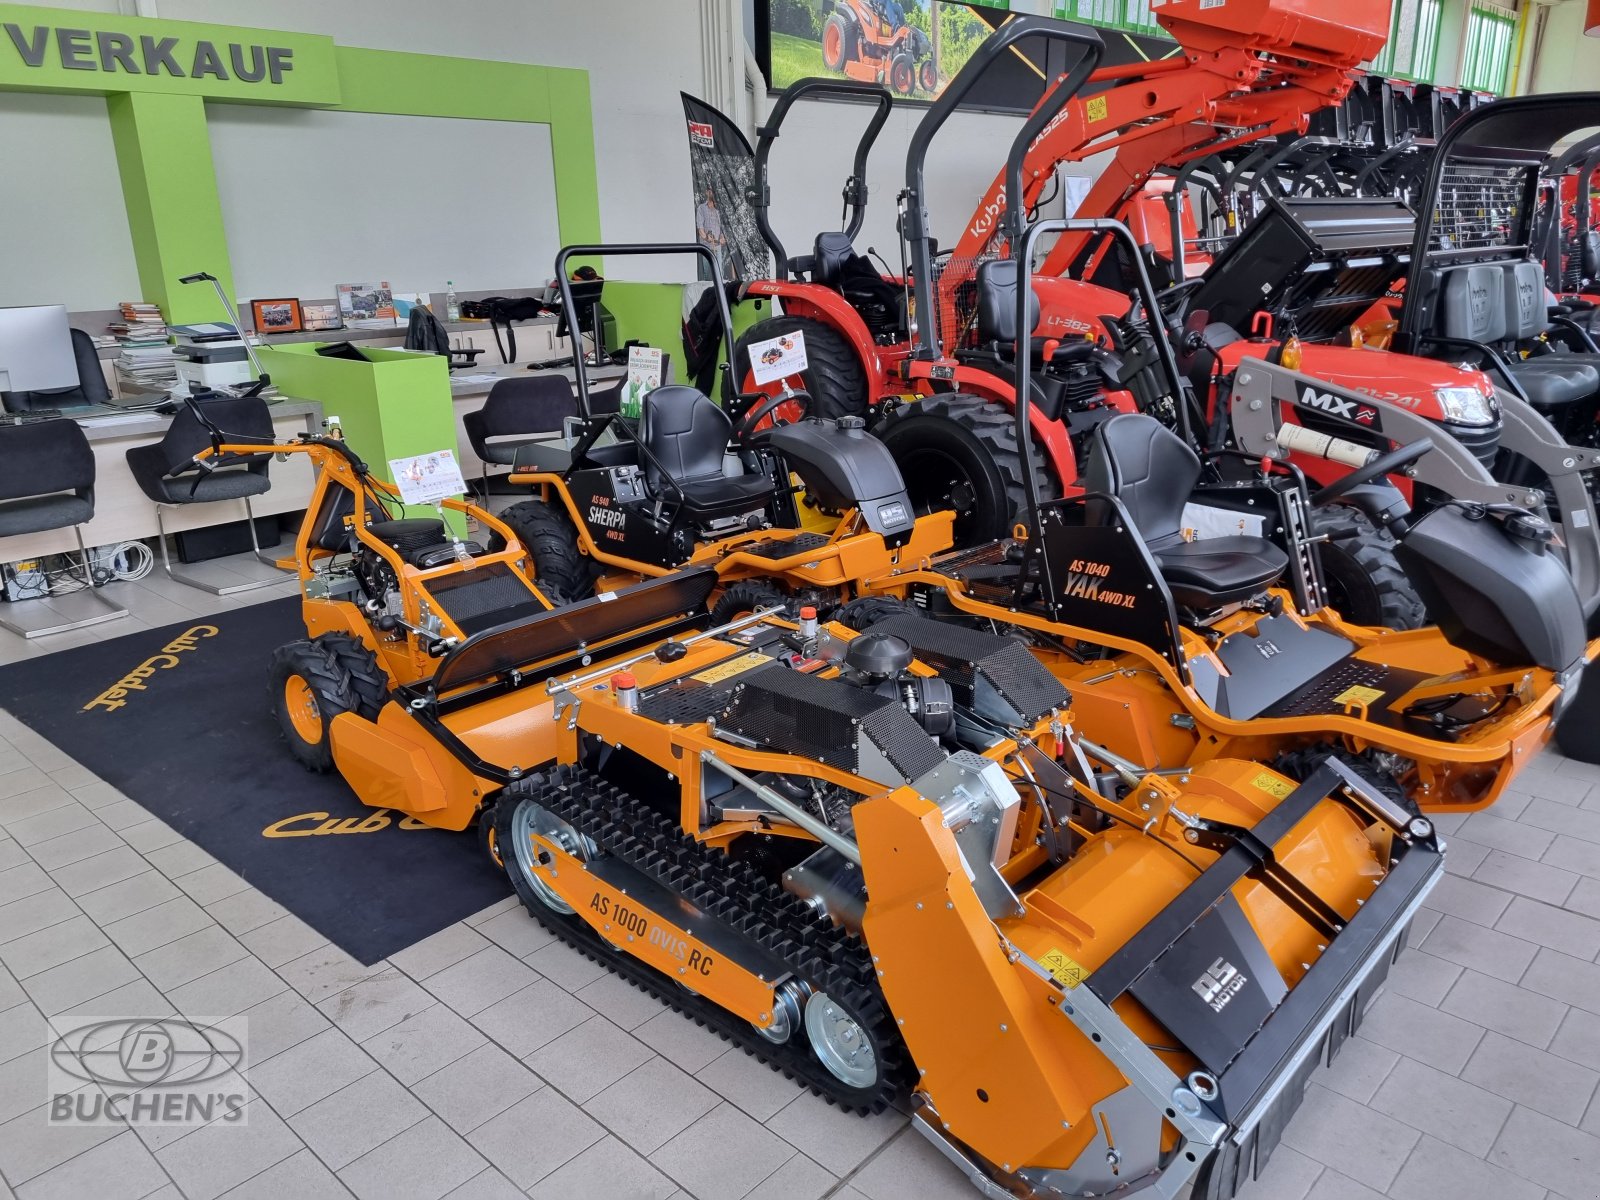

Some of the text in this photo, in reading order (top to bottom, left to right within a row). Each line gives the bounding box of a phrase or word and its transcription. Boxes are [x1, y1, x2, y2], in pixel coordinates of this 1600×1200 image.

[3, 23, 293, 84] VERKAUF
[970, 184, 1007, 237] Kubo
[1047, 315, 1092, 333] L1-382
[1301, 387, 1357, 419] MX
[591, 494, 600, 505] AS
[588, 505, 626, 531] SHERPA
[1069, 559, 1111, 578] AS 1040
[1063, 571, 1136, 609] YAK 4WD XL
[83, 625, 219, 712] Cub Cadet
[262, 808, 392, 838] Cub
[590, 892, 714, 976] AS 1000 OVIS RC
[1208, 973, 1248, 1013] MOTOR
